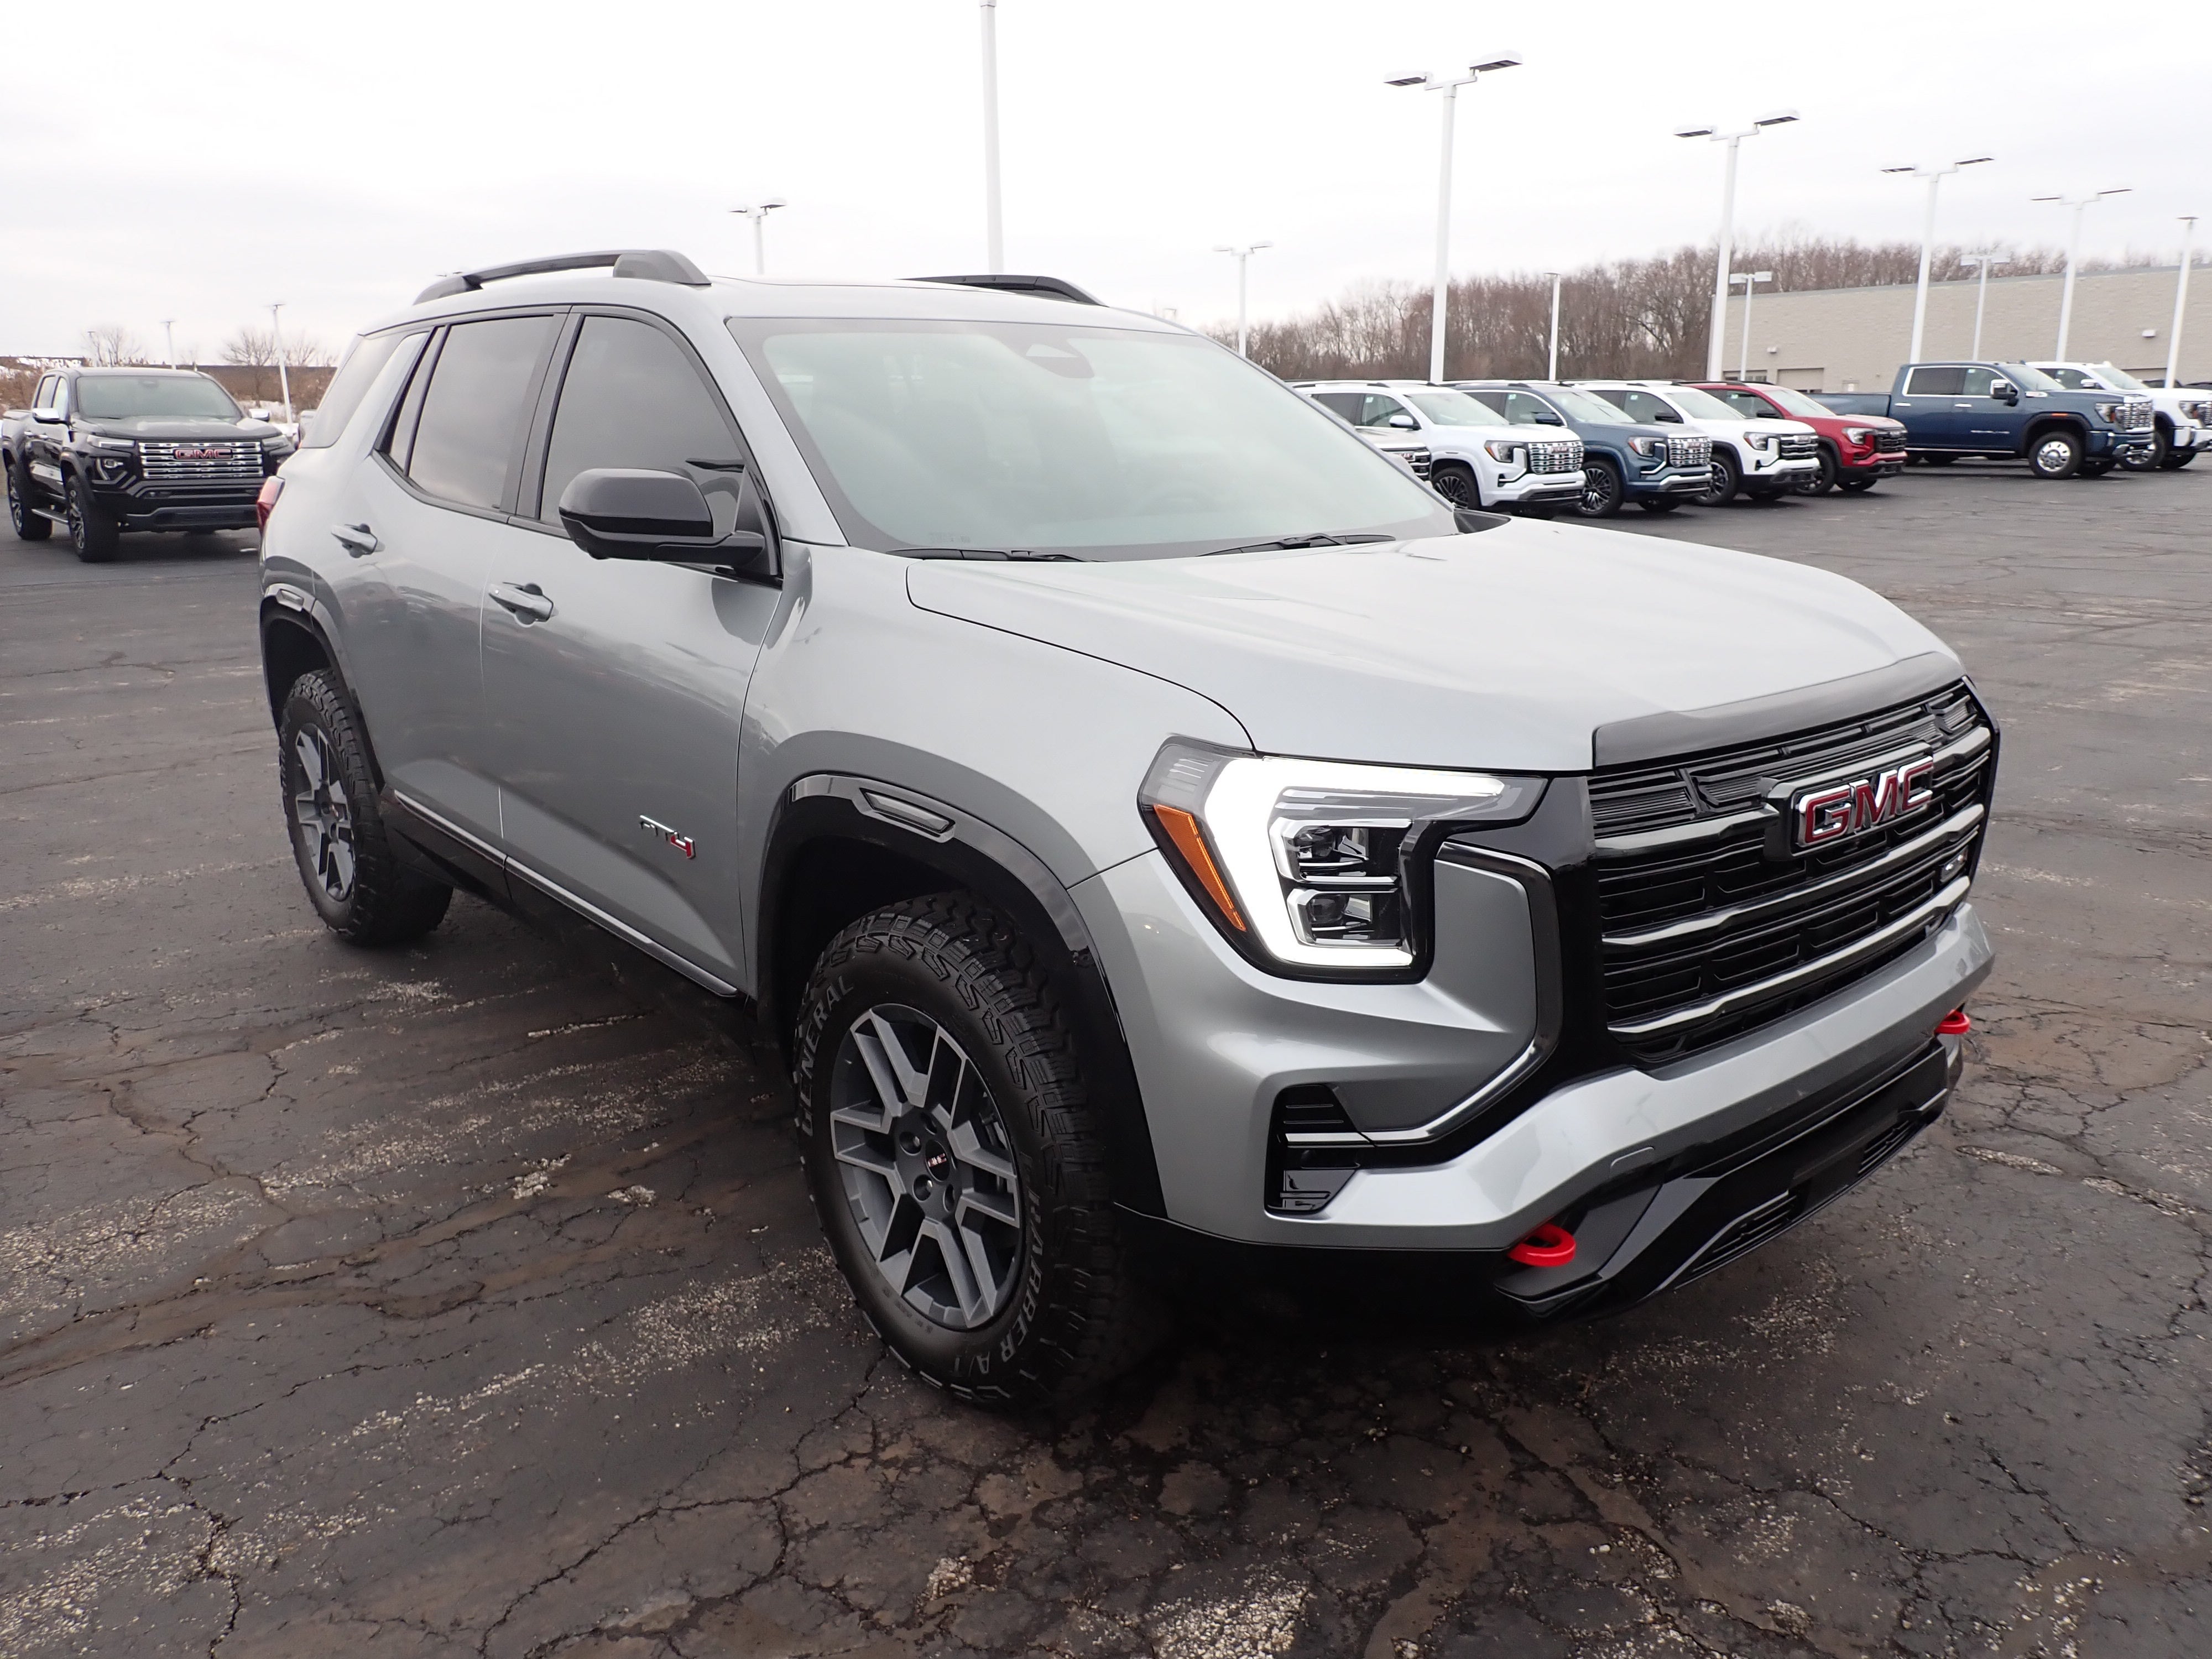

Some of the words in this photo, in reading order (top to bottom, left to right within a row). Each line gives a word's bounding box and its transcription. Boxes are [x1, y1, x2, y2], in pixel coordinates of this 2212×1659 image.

[175, 448, 232, 460] GMC
[1797, 755, 1934, 848] GMC
[800, 974, 854, 1137] GENERAL
